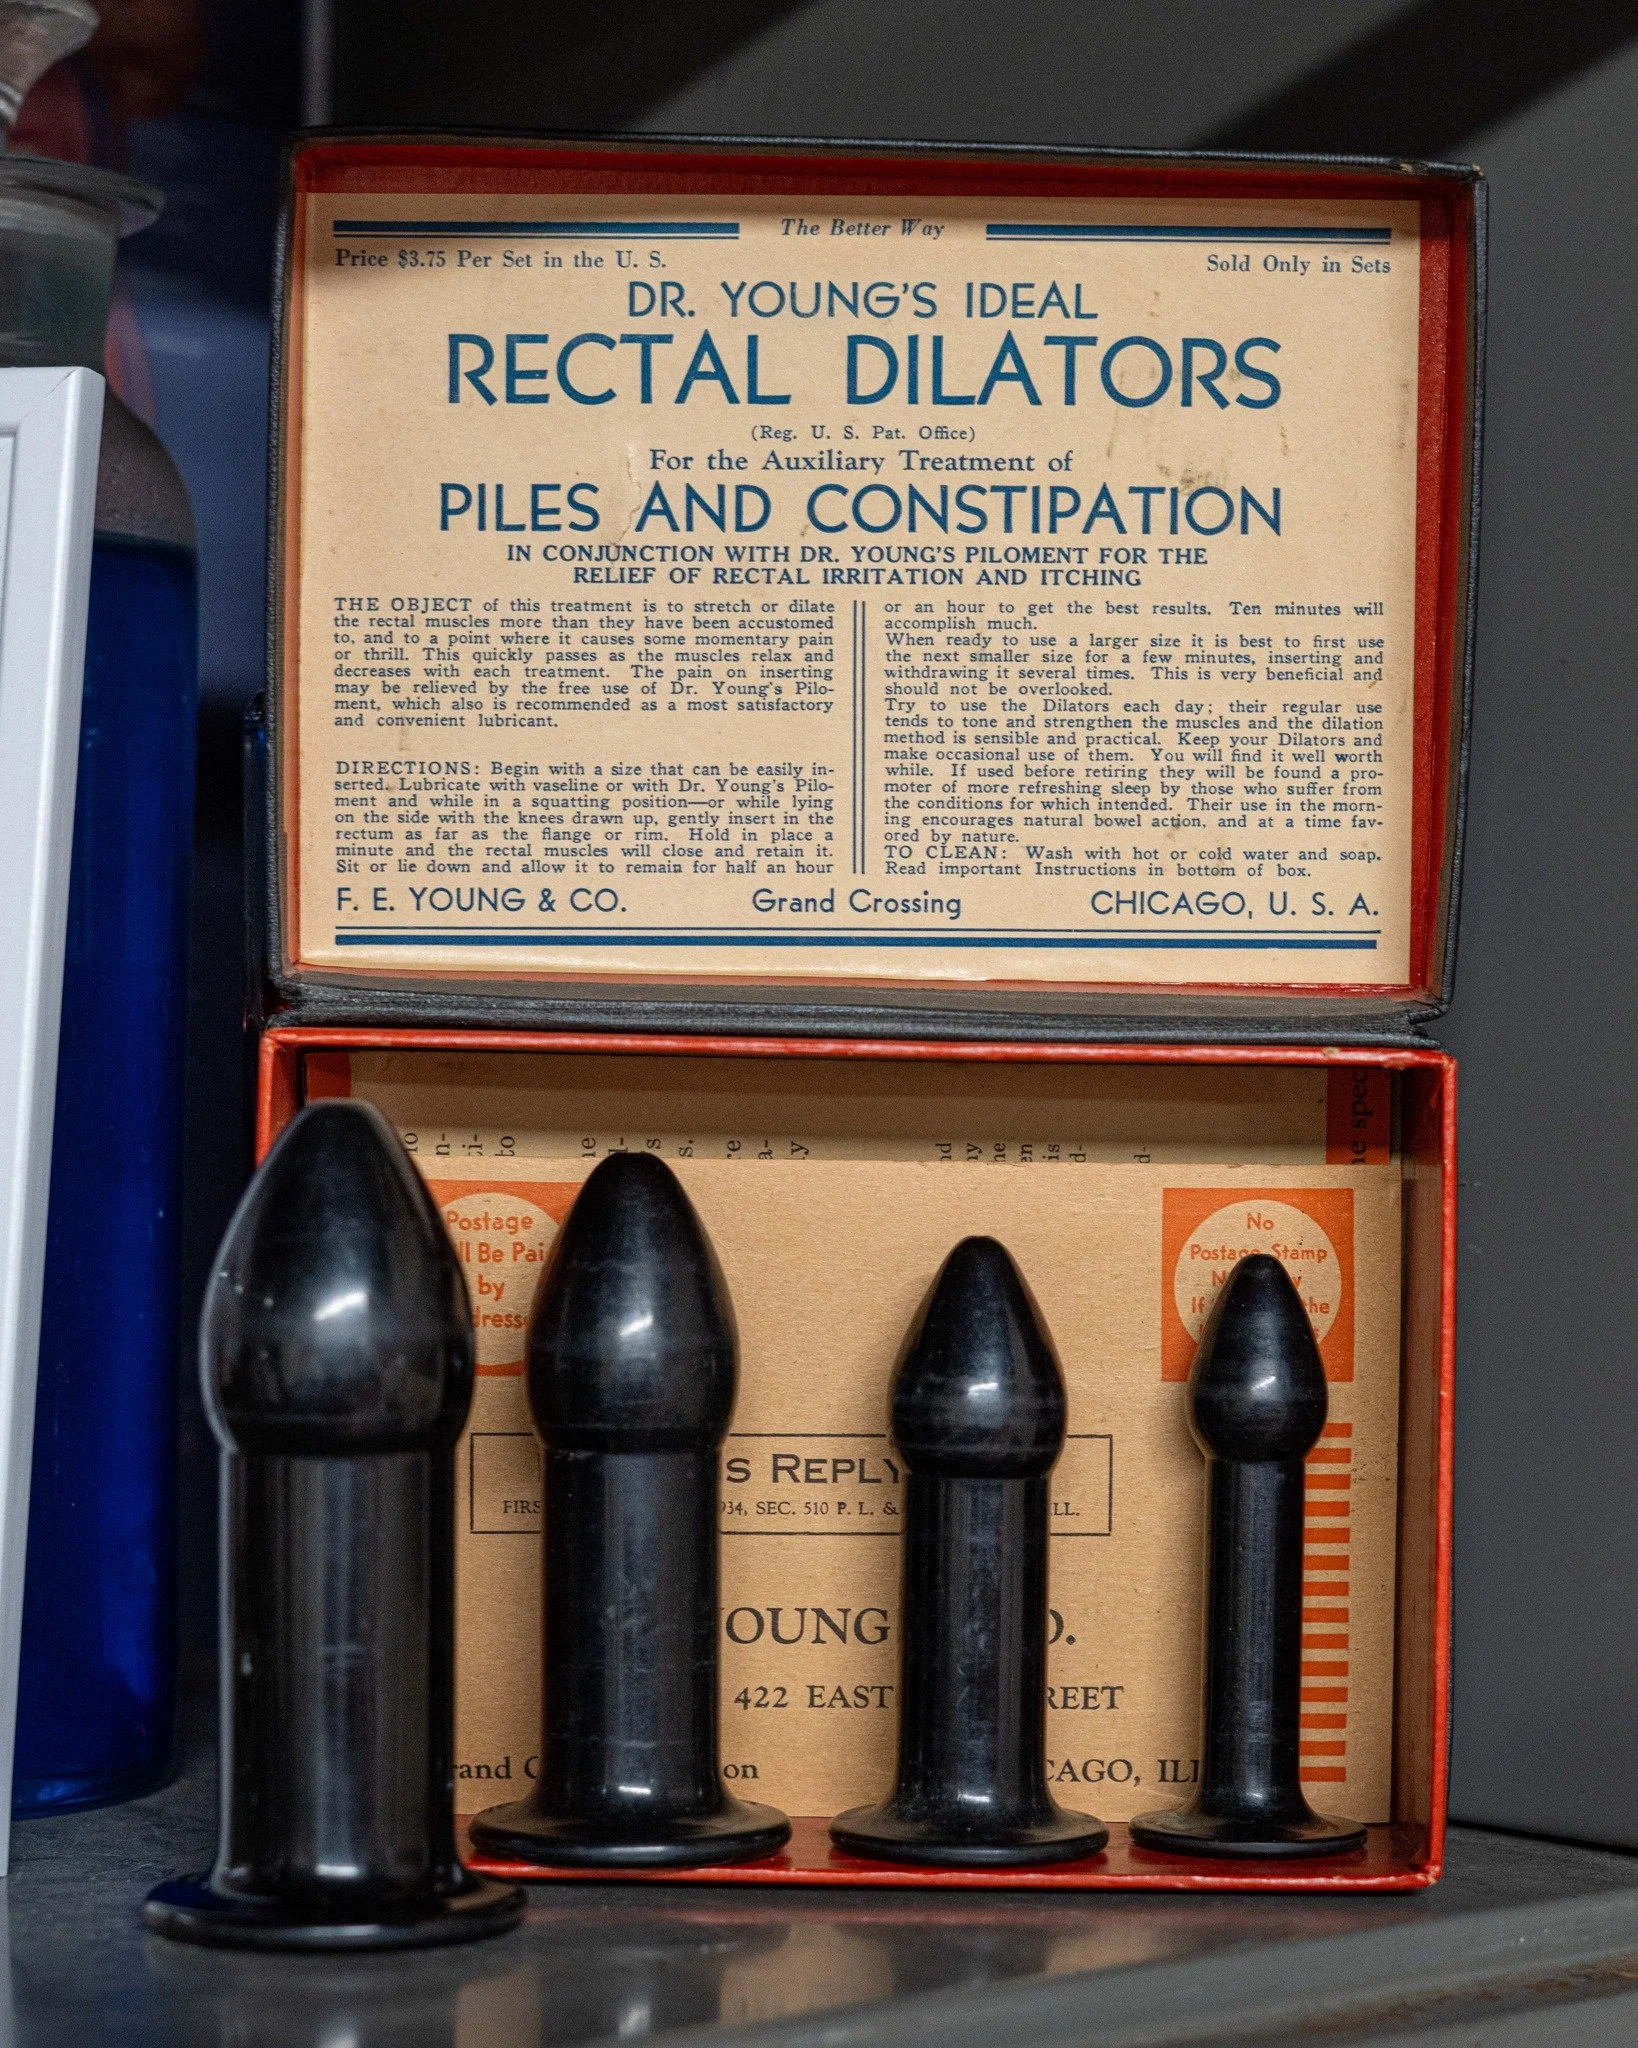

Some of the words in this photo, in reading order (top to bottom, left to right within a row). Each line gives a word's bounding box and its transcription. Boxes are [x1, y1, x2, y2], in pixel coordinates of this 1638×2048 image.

[782, 218, 820, 235] The
[830, 219, 891, 235] Better
[902, 219, 944, 240] Way
[335, 249, 388, 266] Price
[399, 249, 445, 268] $3.75
[458, 250, 492, 267] Per
[503, 250, 532, 267] Set
[544, 251, 562, 267] in
[574, 251, 604, 268] the
[617, 250, 638, 268] U.
[649, 250, 666, 268] S.
[1207, 254, 1250, 272] Sold
[1263, 255, 1310, 276] Only
[1322, 256, 1341, 273] in
[1351, 256, 1391, 273] Sets
[628, 281, 695, 318] DR.
[721, 281, 937, 319] YOUNG'S
[966, 280, 1098, 319] IDEAL
[448, 329, 792, 406] RECTAL
[846, 329, 1281, 410] DILATORS
[751, 425, 797, 442] (Reg.
[811, 425, 830, 439] U.
[844, 425, 859, 440] S.
[872, 425, 905, 439] Pat.
[918, 425, 975, 443] Office)
[650, 449, 694, 470] For
[707, 448, 748, 470] the
[761, 449, 885, 475] Auxiliary
[898, 450, 1035, 472] Treatment
[1048, 450, 1073, 472] of
[440, 482, 600, 532] PILES
[634, 480, 772, 533] AND
[806, 482, 1282, 537] CONSTIPATION
[507, 545, 531, 562] IN
[542, 545, 714, 564] CONJUNCTION
[724, 546, 790, 565] WITH
[800, 546, 839, 565] DR.
[851, 546, 955, 565] YOUNG'S
[965, 546, 1089, 565] PILOMENT
[1099, 547, 1148, 566] FOR
[1158, 548, 1208, 565] THE
[573, 567, 656, 584] RELIEF
[669, 567, 701, 584] OF
[712, 567, 810, 585] RECTAL
[822, 568, 964, 585] IRRITATION
[975, 569, 1027, 585] AND
[1041, 569, 1141, 586] ITCHING
[334, 597, 379, 611] THE
[391, 597, 472, 614] OBJECT
[483, 598, 499, 611] of
[510, 598, 540, 612] this
[551, 601, 632, 612] treatment
[643, 599, 657, 612] is
[667, 602, 684, 612] to
[694, 599, 751, 613] stretch
[761, 603, 778, 613] or
[788, 599, 835, 613] dilate
[884, 603, 902, 612] or
[914, 603, 934, 613] an
[947, 600, 985, 613] hour
[999, 602, 1015, 613] to
[1028, 602, 1053, 617] get
[1067, 600, 1092, 614] the
[1105, 601, 1139, 615] best
[1152, 601, 1211, 615] results.
[1229, 601, 1262, 615] Ten
[1275, 601, 1341, 616] minutes
[1353, 602, 1384, 616] will
[885, 616, 976, 632] accomplish
[987, 616, 1037, 630] much.
[885, 682, 939, 695] should
[950, 684, 977, 695] not
[989, 683, 1007, 697] be
[1019, 683, 1113, 697] overlooked.
[884, 697, 916, 714] Try
[930, 700, 946, 711] to
[960, 702, 987, 711] use
[1001, 698, 1027, 712] the
[1043, 698, 1109, 712] Dilators
[1123, 699, 1159, 712] each
[1175, 699, 1212, 715] day;
[1229, 699, 1267, 713] their
[1282, 700, 1342, 716] regular
[1356, 704, 1382, 714] use
[334, 713, 364, 726] and
[377, 713, 465, 727] convenient
[478, 713, 558, 727] lubricant.
[336, 761, 479, 775] DIRECTIONS:
[491, 761, 539, 779] Begin
[548, 762, 585, 775] with
[594, 766, 603, 775] a
[611, 762, 642, 776] size
[650, 762, 683, 776] that
[692, 765, 720, 776] can
[729, 762, 748, 776] be
[756, 762, 803, 779] easily
[812, 762, 834, 776] in-
[884, 828, 919, 842] ored
[930, 829, 952, 843] by
[962, 832, 1019, 843] nature.
[884, 845, 913, 859] TO
[926, 844, 1006, 859] CLEAN:
[1025, 845, 1073, 859] Wash
[1084, 846, 1121, 860] with
[1133, 846, 1159, 860] hot
[1170, 850, 1188, 860] or
[1199, 847, 1232, 861] cold
[1243, 850, 1289, 860] water
[1298, 847, 1328, 860] and
[1340, 851, 1381, 863] soap.
[885, 861, 926, 875] Read
[939, 861, 1021, 878] important
[1035, 862, 1136, 876] Instructions
[1148, 863, 1164, 876] in
[1177, 863, 1236, 876] bottom
[1247, 863, 1263, 877] of
[1277, 863, 1311, 877] box.
[337, 887, 359, 911] F.
[373, 887, 395, 911] E.
[409, 887, 526, 912] YOUNG
[538, 888, 556, 912] &
[569, 888, 627, 912] CO.
[752, 888, 835, 913] Grand
[849, 888, 961, 920] Crossing
[1091, 890, 1253, 919] CHICAGO,
[1269, 891, 1296, 916] U.
[1312, 892, 1334, 916] S.
[1348, 893, 1379, 916] A.
[446, 1210, 533, 1235] Postage
[1246, 1212, 1275, 1231] No
[478, 1241, 505, 1263] Be
[512, 1240, 545, 1263] Pai
[1271, 1243, 1328, 1263] Stamp
[478, 1273, 505, 1301] by
[1191, 1296, 1206, 1314] If
[1304, 1296, 1330, 1314] he
[772, 1453, 900, 1484] REPLY
[502, 1500, 541, 1514] FIRS
[756, 1501, 796, 1515] SEC.
[803, 1501, 829, 1515] 510
[837, 1501, 851, 1515] P.
[858, 1501, 875, 1515] L.
[723, 1606, 891, 1645] OUNG
[734, 1686, 789, 1711] 422
[806, 1685, 894, 1709] EAST
[1047, 1685, 1125, 1710] REET
